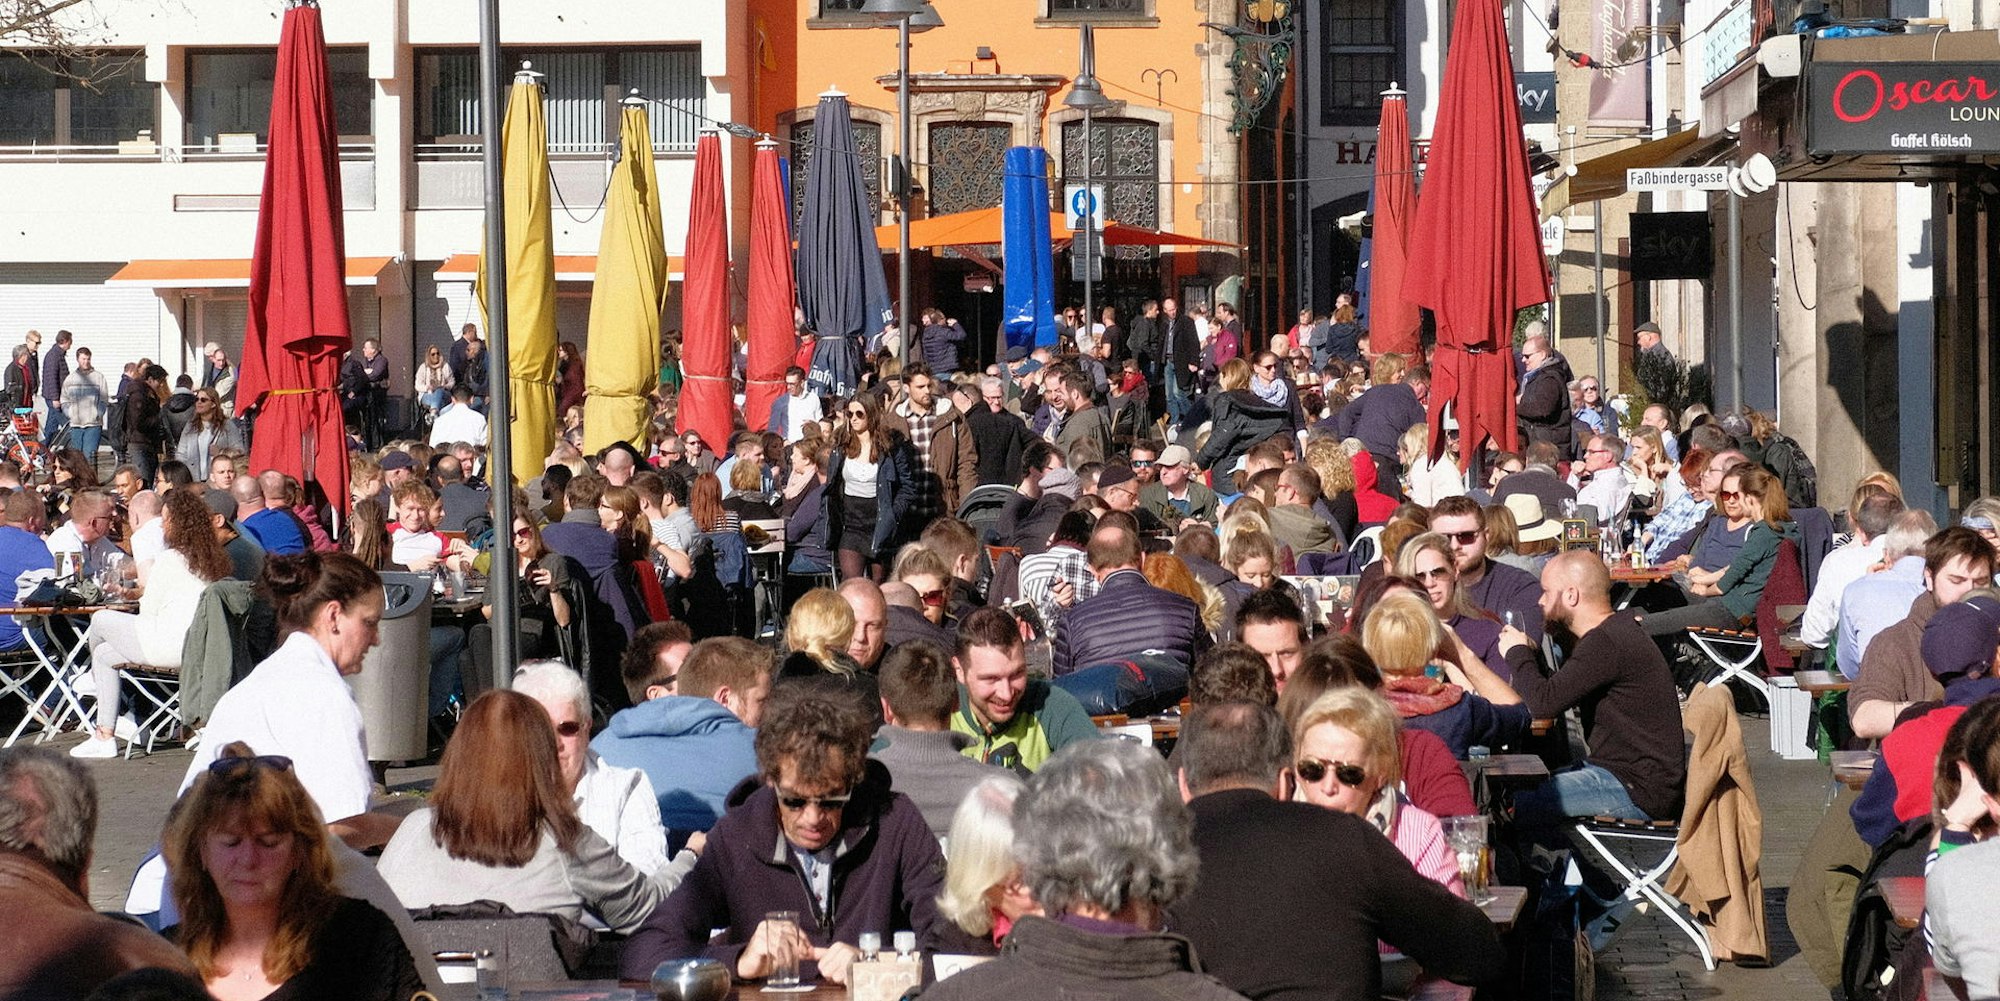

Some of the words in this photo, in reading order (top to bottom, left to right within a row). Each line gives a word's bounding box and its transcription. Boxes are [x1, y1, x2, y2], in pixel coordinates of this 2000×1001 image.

[1517, 84, 1549, 112] ky
[1833, 69, 1998, 123] Oscar
[1891, 132, 1927, 148] Gaffel
[1930, 132, 1972, 148] Kölsch
[1630, 171, 1723, 186] Faßbindergasse
